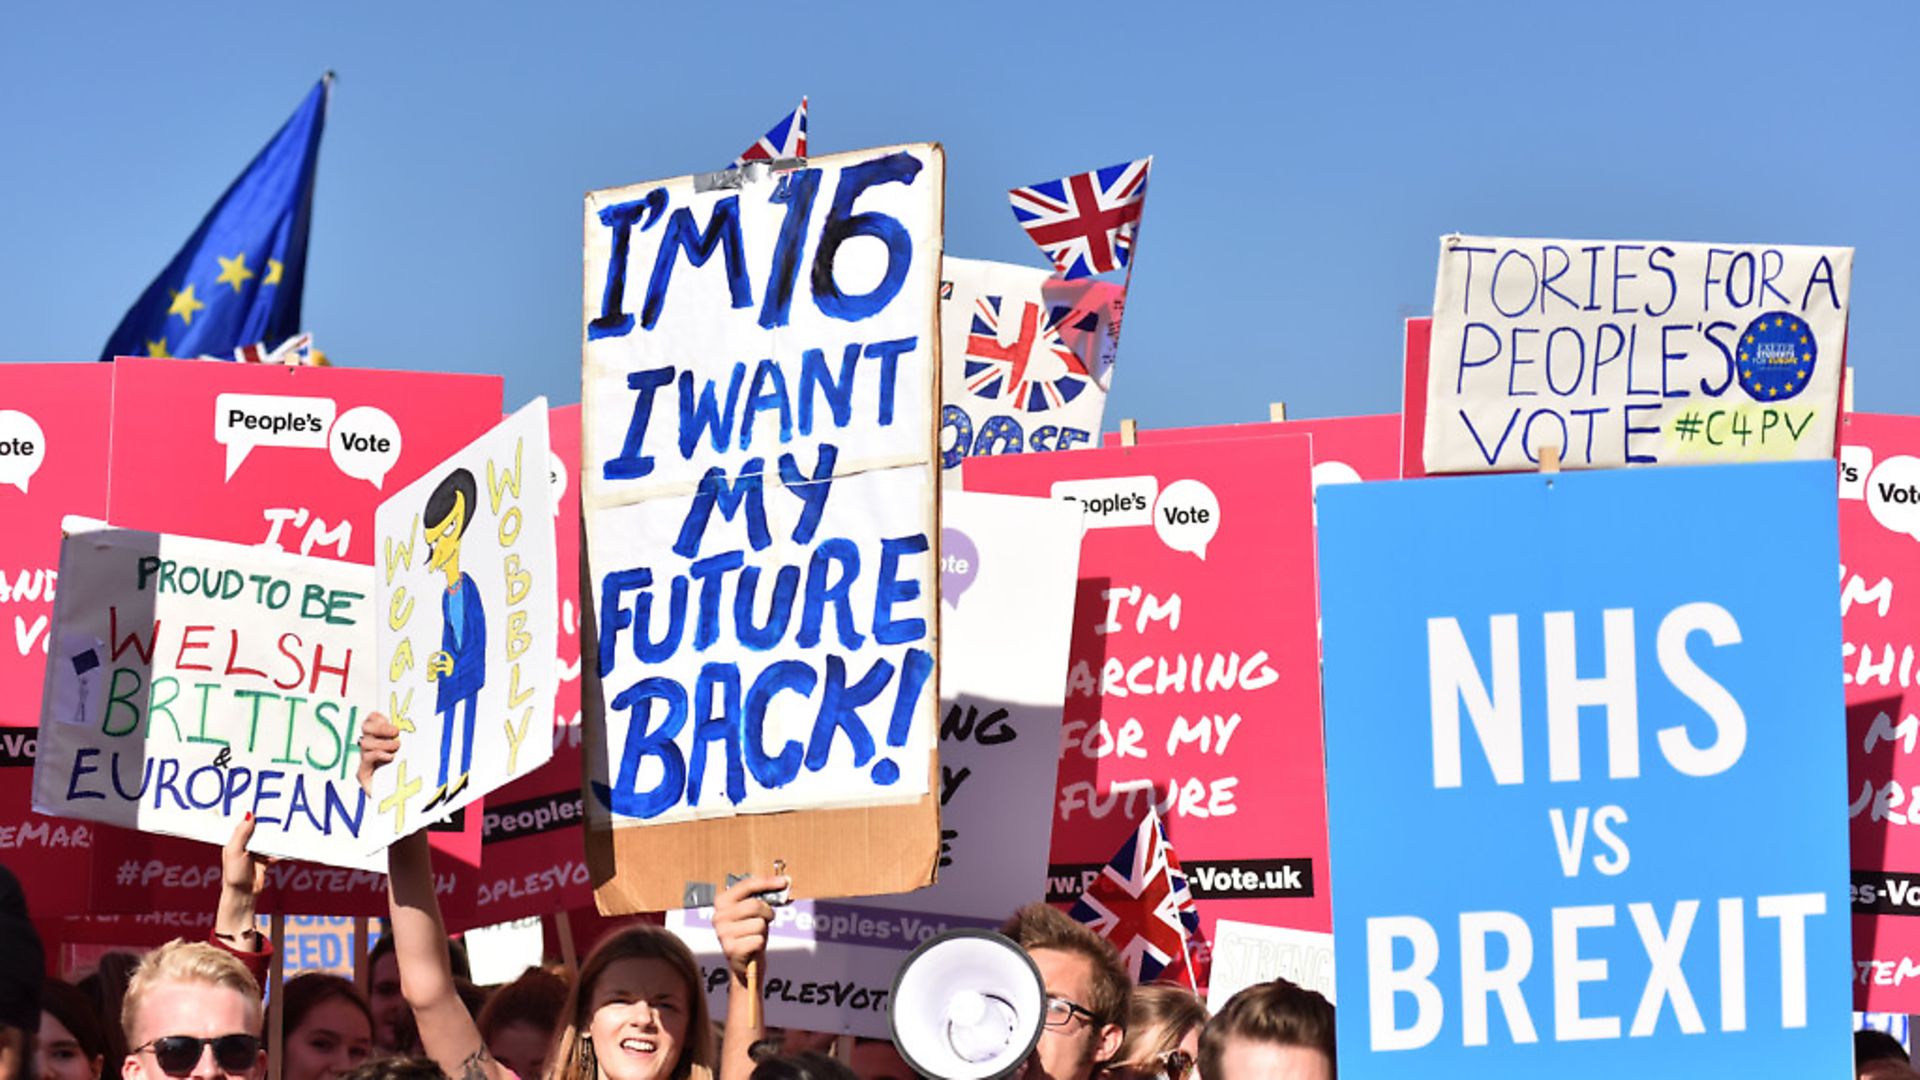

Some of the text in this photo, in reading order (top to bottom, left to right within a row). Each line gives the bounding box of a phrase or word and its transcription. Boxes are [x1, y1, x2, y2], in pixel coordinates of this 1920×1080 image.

[587, 151, 923, 341] I'M 16
[1449, 245, 1841, 318] TORIES FOR A
[1456, 321, 1740, 398] PEOPLE'S
[228, 410, 391, 454] People's Vote
[603, 336, 919, 480] I WANT
[1459, 403, 1815, 466] VOTE #C4PV
[0, 437, 34, 456] ote
[252, 509, 352, 557] I'M
[672, 443, 838, 559] MY
[1063, 492, 1210, 525] ople's Vote
[137, 556, 365, 625] PROUD TO BE
[486, 437, 535, 775] WOBBLY
[597, 533, 929, 677] FUTURE
[1094, 585, 1182, 635] I'M
[110, 606, 352, 698] WELSH
[1064, 650, 1279, 697] ARCHING
[1427, 601, 1747, 789] NHS
[212, 746, 233, 770] &
[591, 648, 934, 819] BACK!
[1058, 717, 1147, 760] FOR
[1166, 713, 1241, 756] MY
[66, 749, 366, 838] EUROPEAN
[1059, 776, 1239, 820] FUTURE
[1548, 804, 1631, 878] VS
[1366, 892, 1827, 1053] BREXIT
